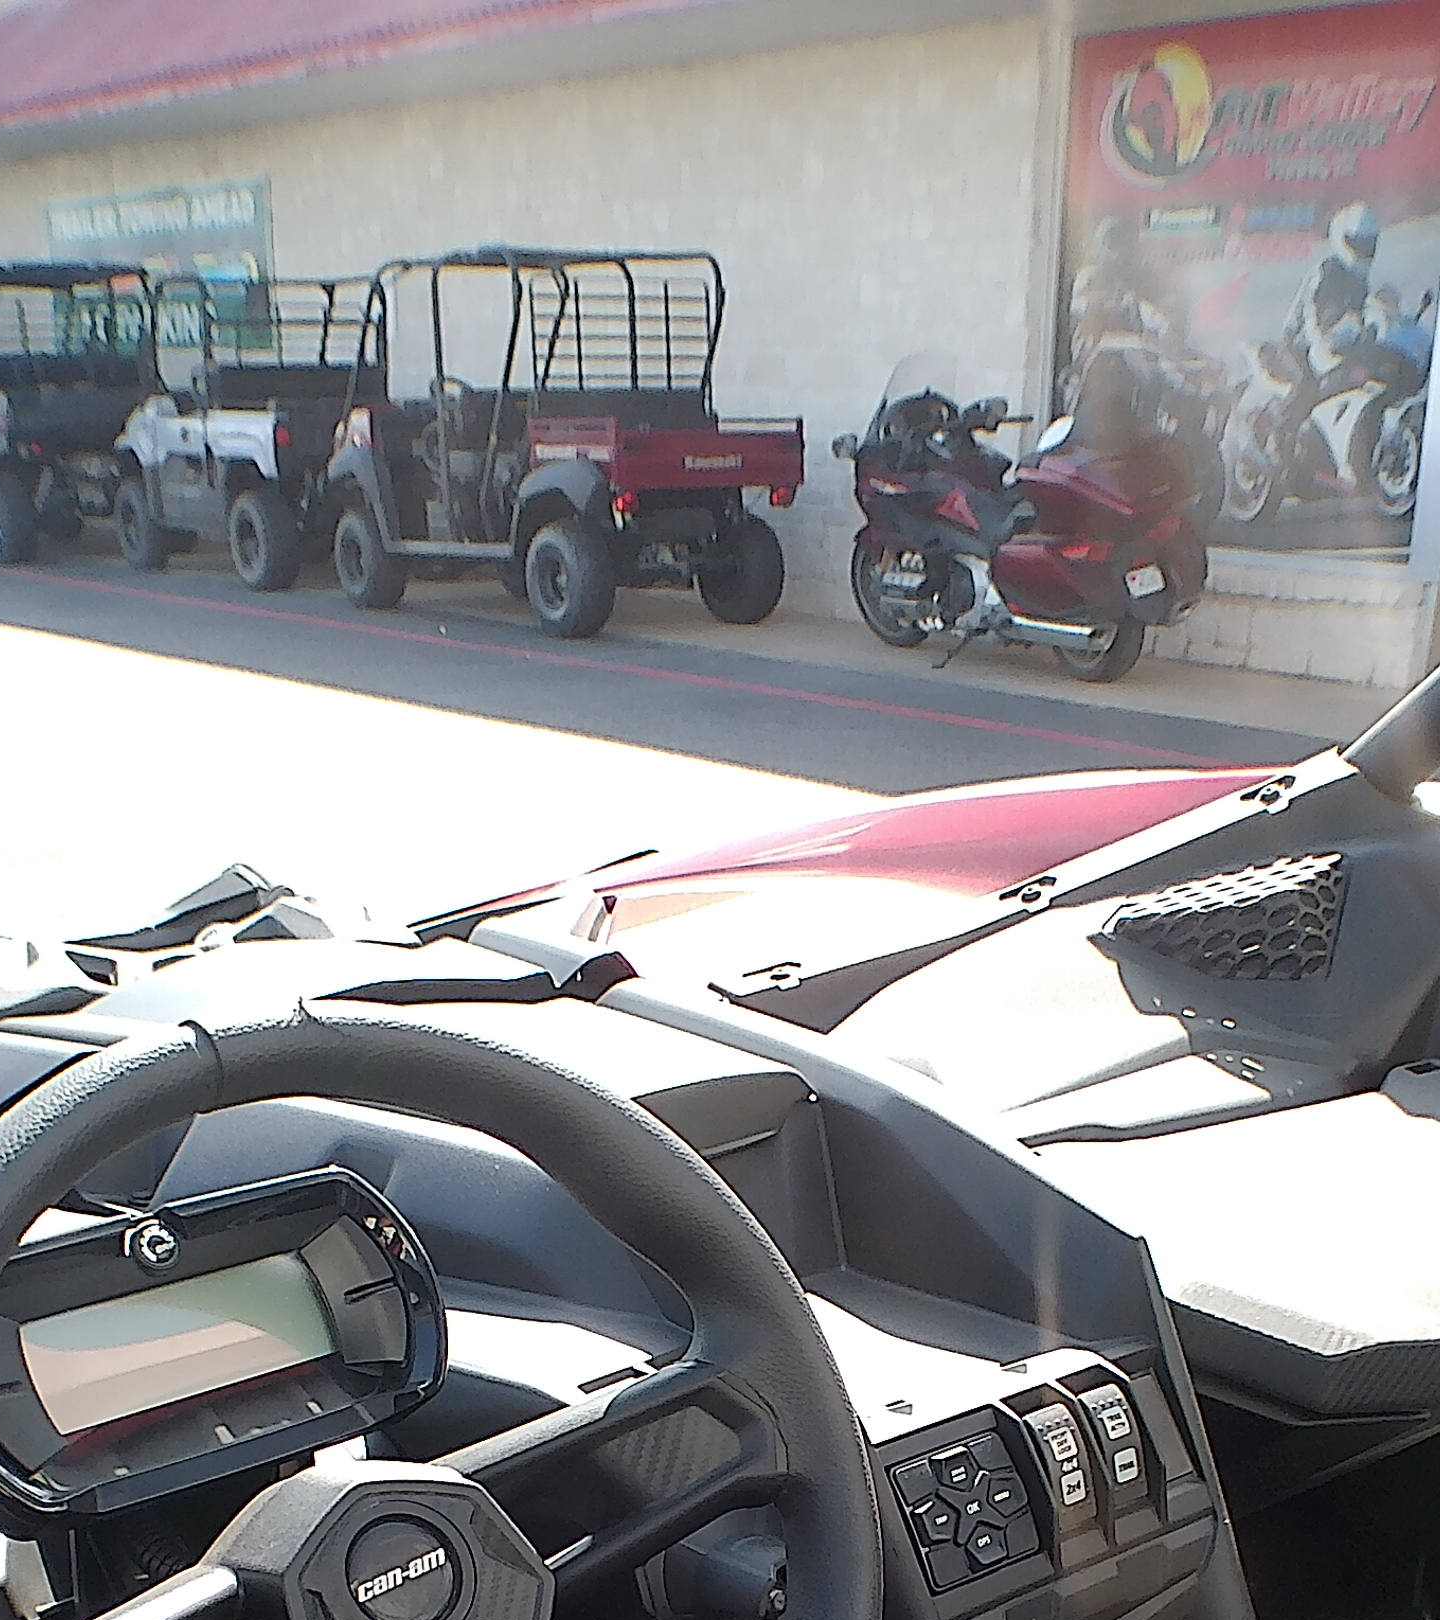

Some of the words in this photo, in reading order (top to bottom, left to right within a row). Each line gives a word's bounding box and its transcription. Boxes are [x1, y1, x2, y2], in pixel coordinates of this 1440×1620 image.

[1066, 1480, 1082, 1496] 2x4
[966, 1500, 981, 1515] OK
[357, 1547, 446, 1603] can-am
